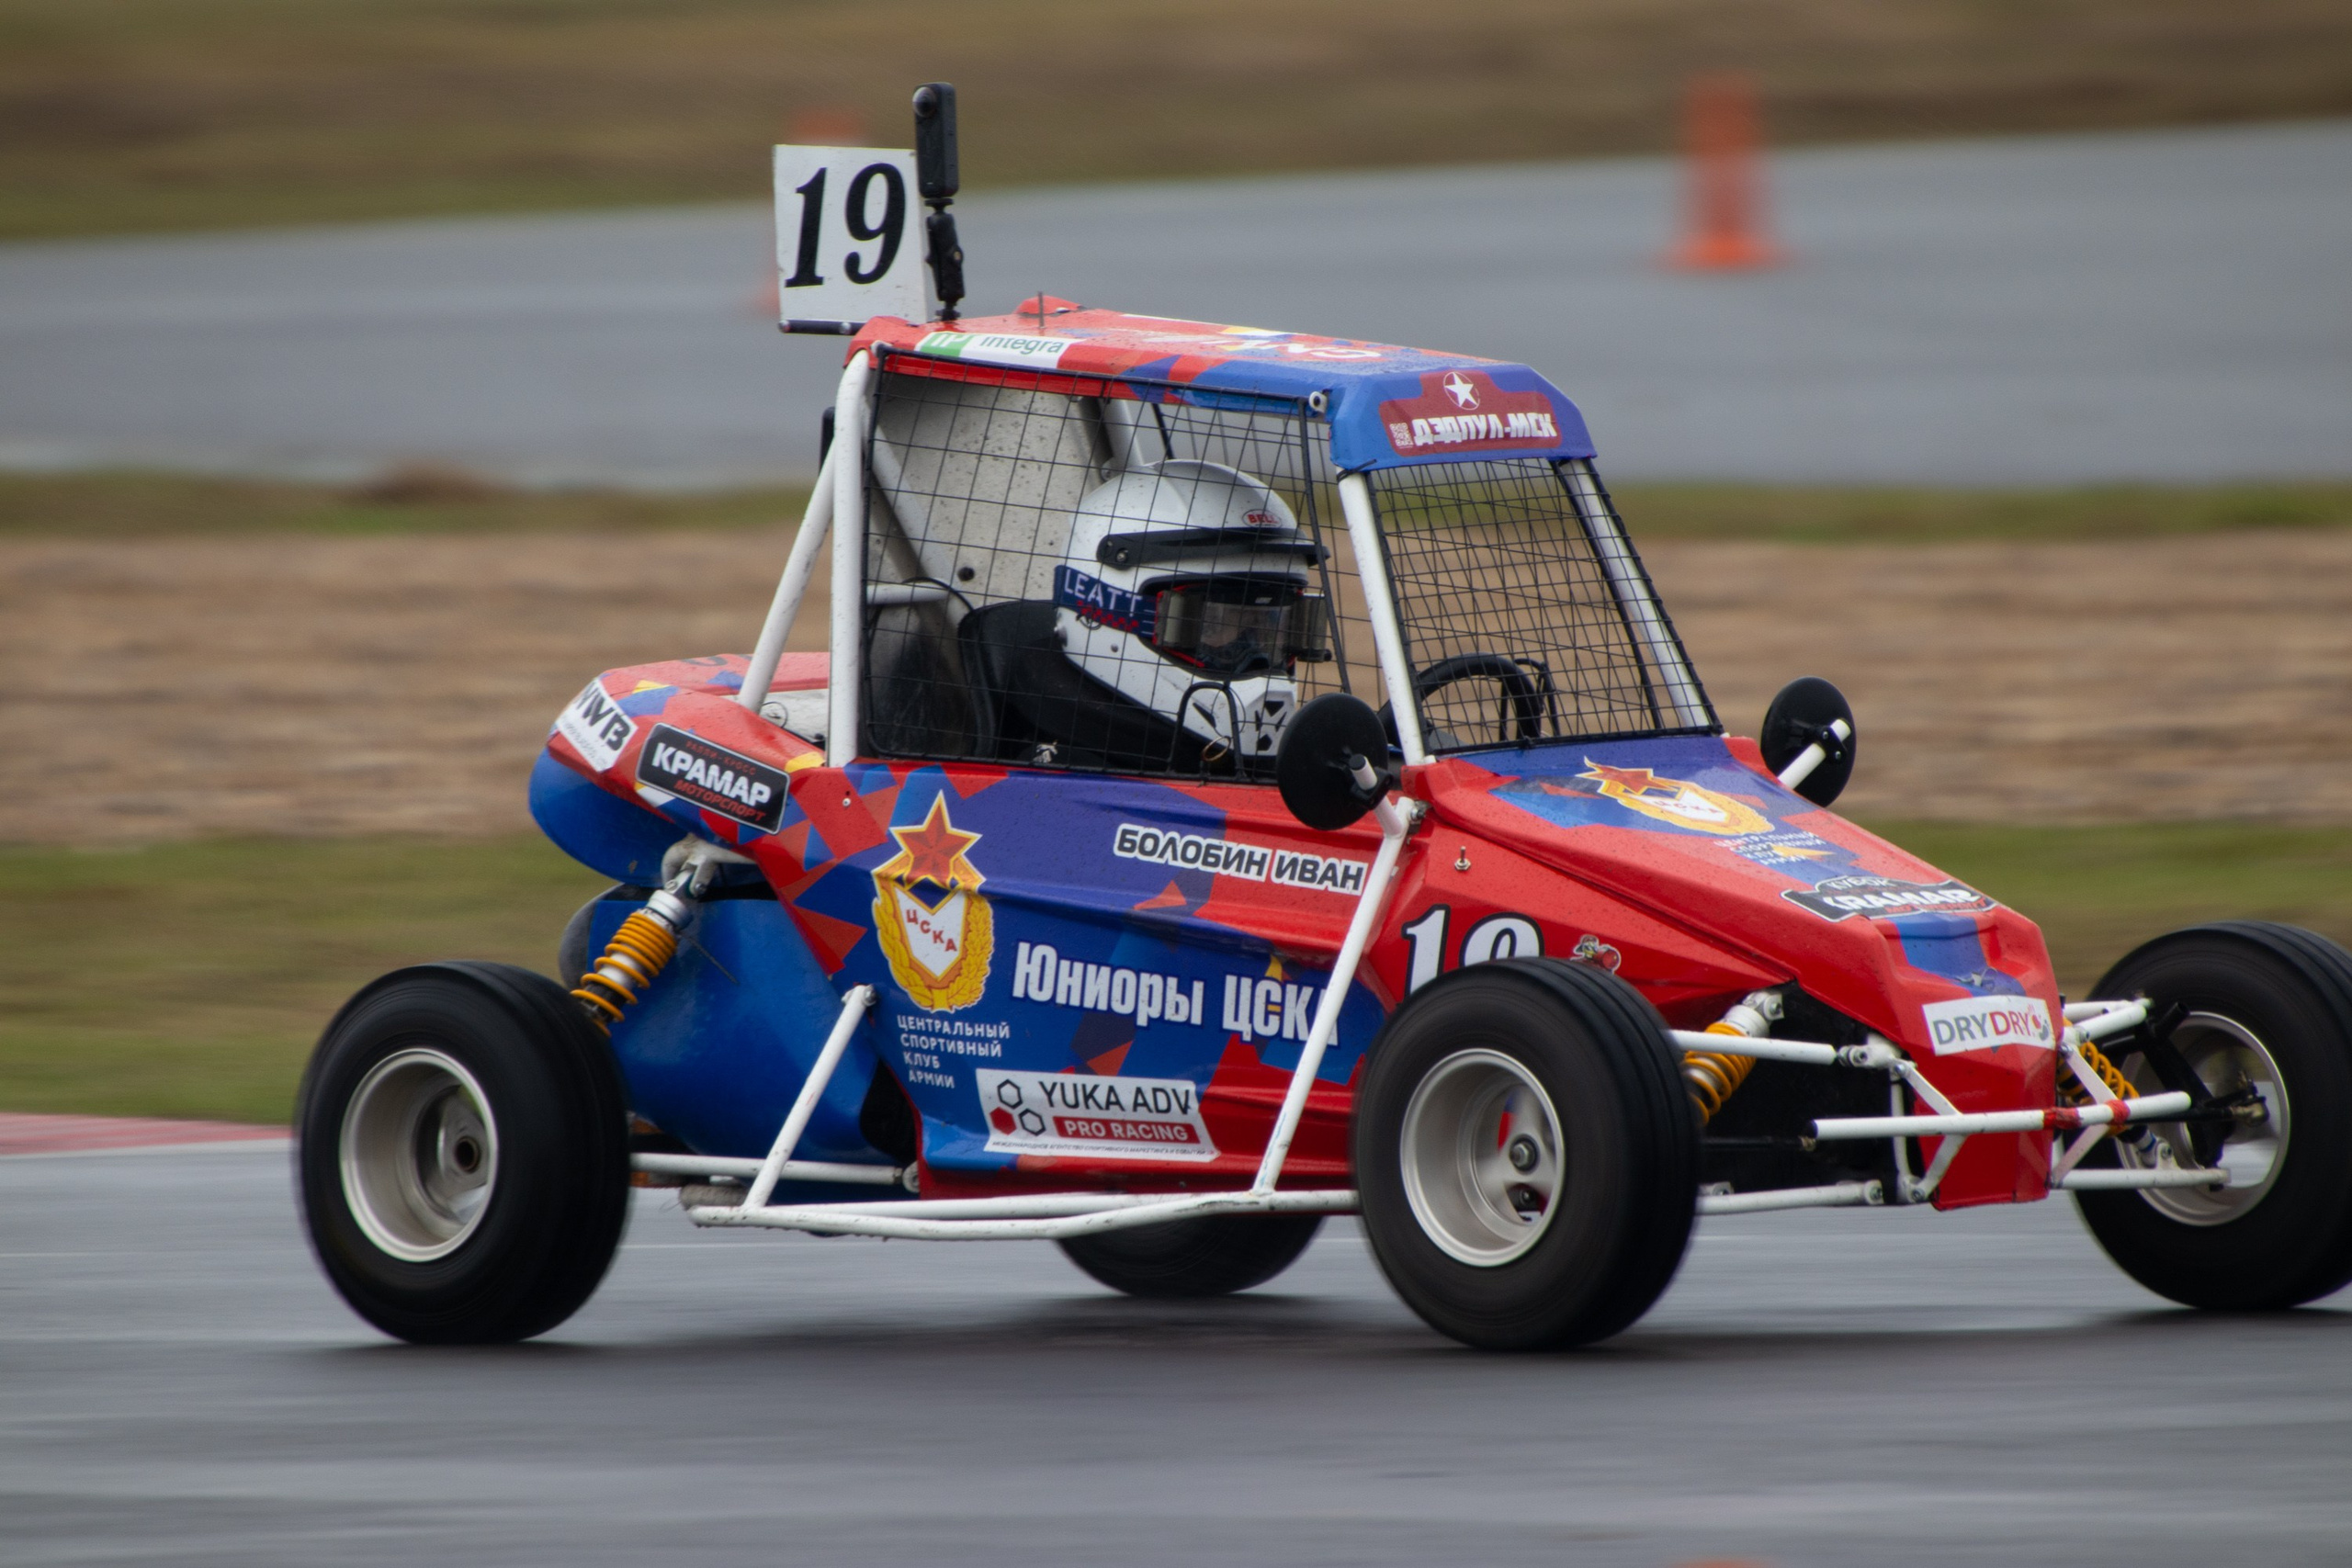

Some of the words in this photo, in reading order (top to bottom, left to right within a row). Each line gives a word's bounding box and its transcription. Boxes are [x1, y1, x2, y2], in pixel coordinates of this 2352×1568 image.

[785, 163, 906, 288] 19
[1412, 412, 1557, 446] ДЭДПУЛ-МСК
[1248, 514, 1279, 524] BELL
[1065, 570, 1143, 617] LEATT
[651, 742, 771, 807] КРАМАР
[673, 780, 766, 821] МОТОРСПОРТ
[1117, 829, 1267, 876] БОЛОБИН
[1275, 854, 1363, 891] ИВАН
[906, 909, 957, 952] ЦСКА
[1012, 942, 1204, 1027] Юниоры
[897, 1015, 1010, 1039] ЦЕНТРАЛЬНЫЙ
[900, 1033, 1002, 1057] СПОРТИВНЫЙ
[903, 1052, 940, 1068] КЛУБ
[909, 1070, 955, 1089] АРМИИ
[1038, 1081, 1125, 1111] YUKA
[1132, 1087, 1192, 1115] ADV
[1064, 1121, 1105, 1137] PRO
[1110, 1122, 1188, 1141] RACING
